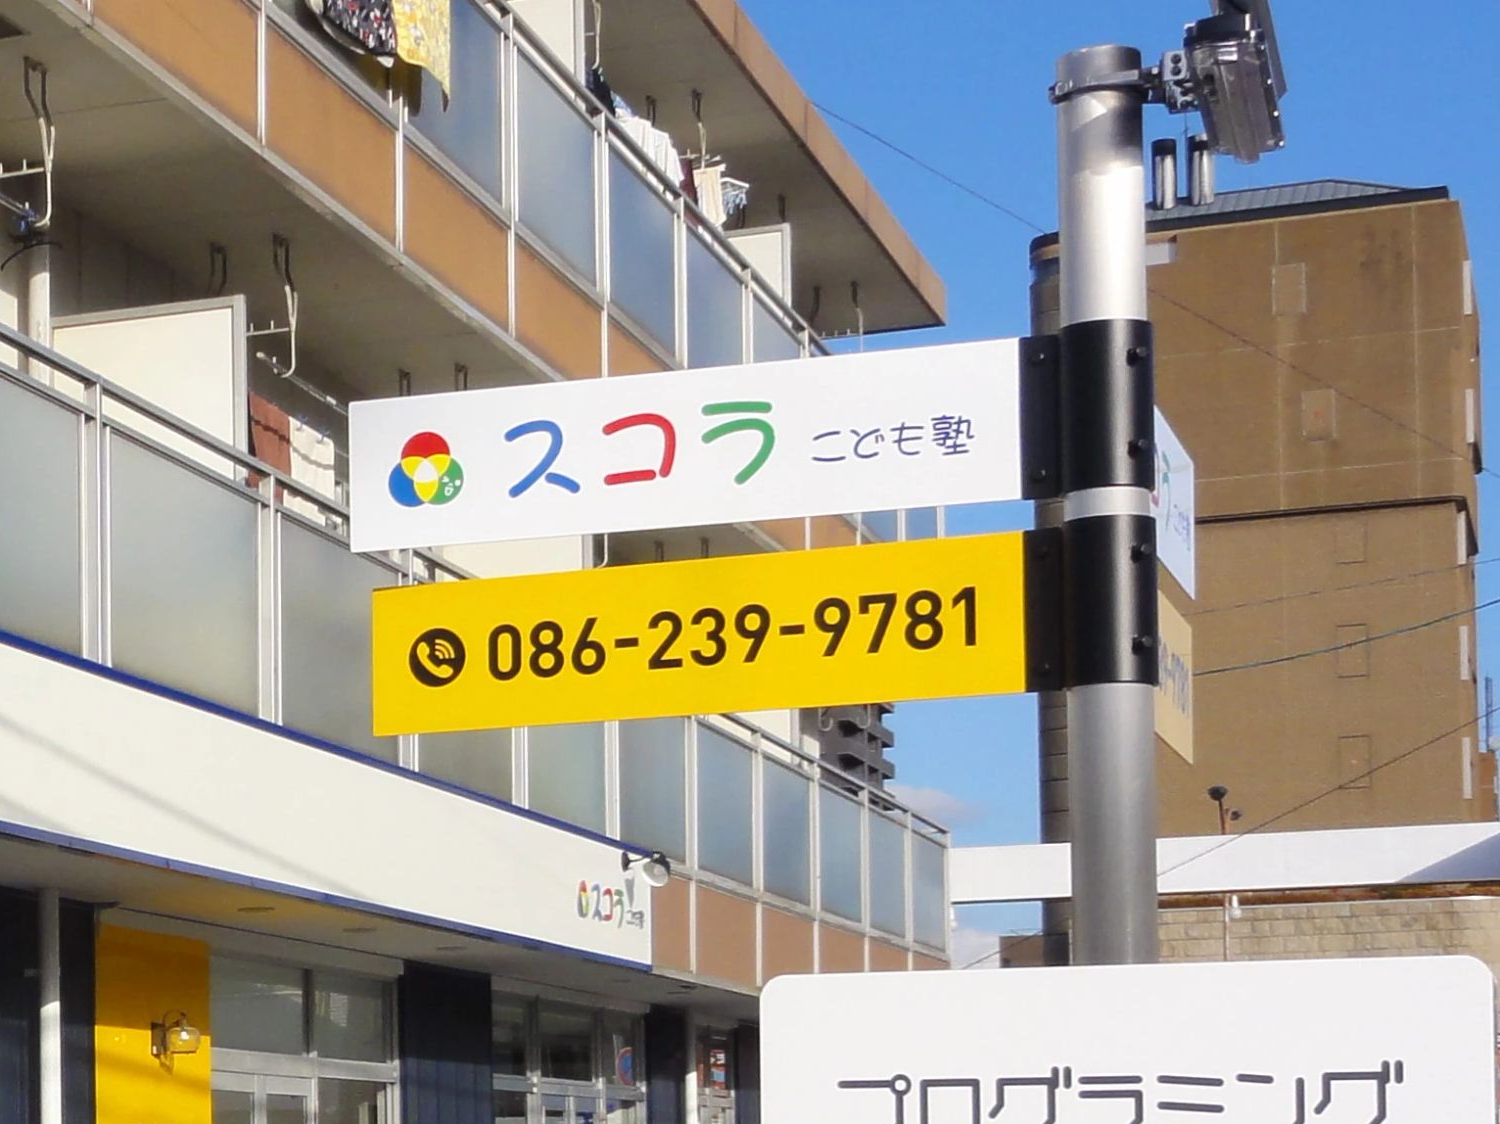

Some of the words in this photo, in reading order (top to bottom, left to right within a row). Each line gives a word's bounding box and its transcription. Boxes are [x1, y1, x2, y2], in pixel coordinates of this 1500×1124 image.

[503, 400, 776, 498] スコラ
[811, 414, 975, 462] こども塾
[487, 586, 979, 682] 086-239-9781
